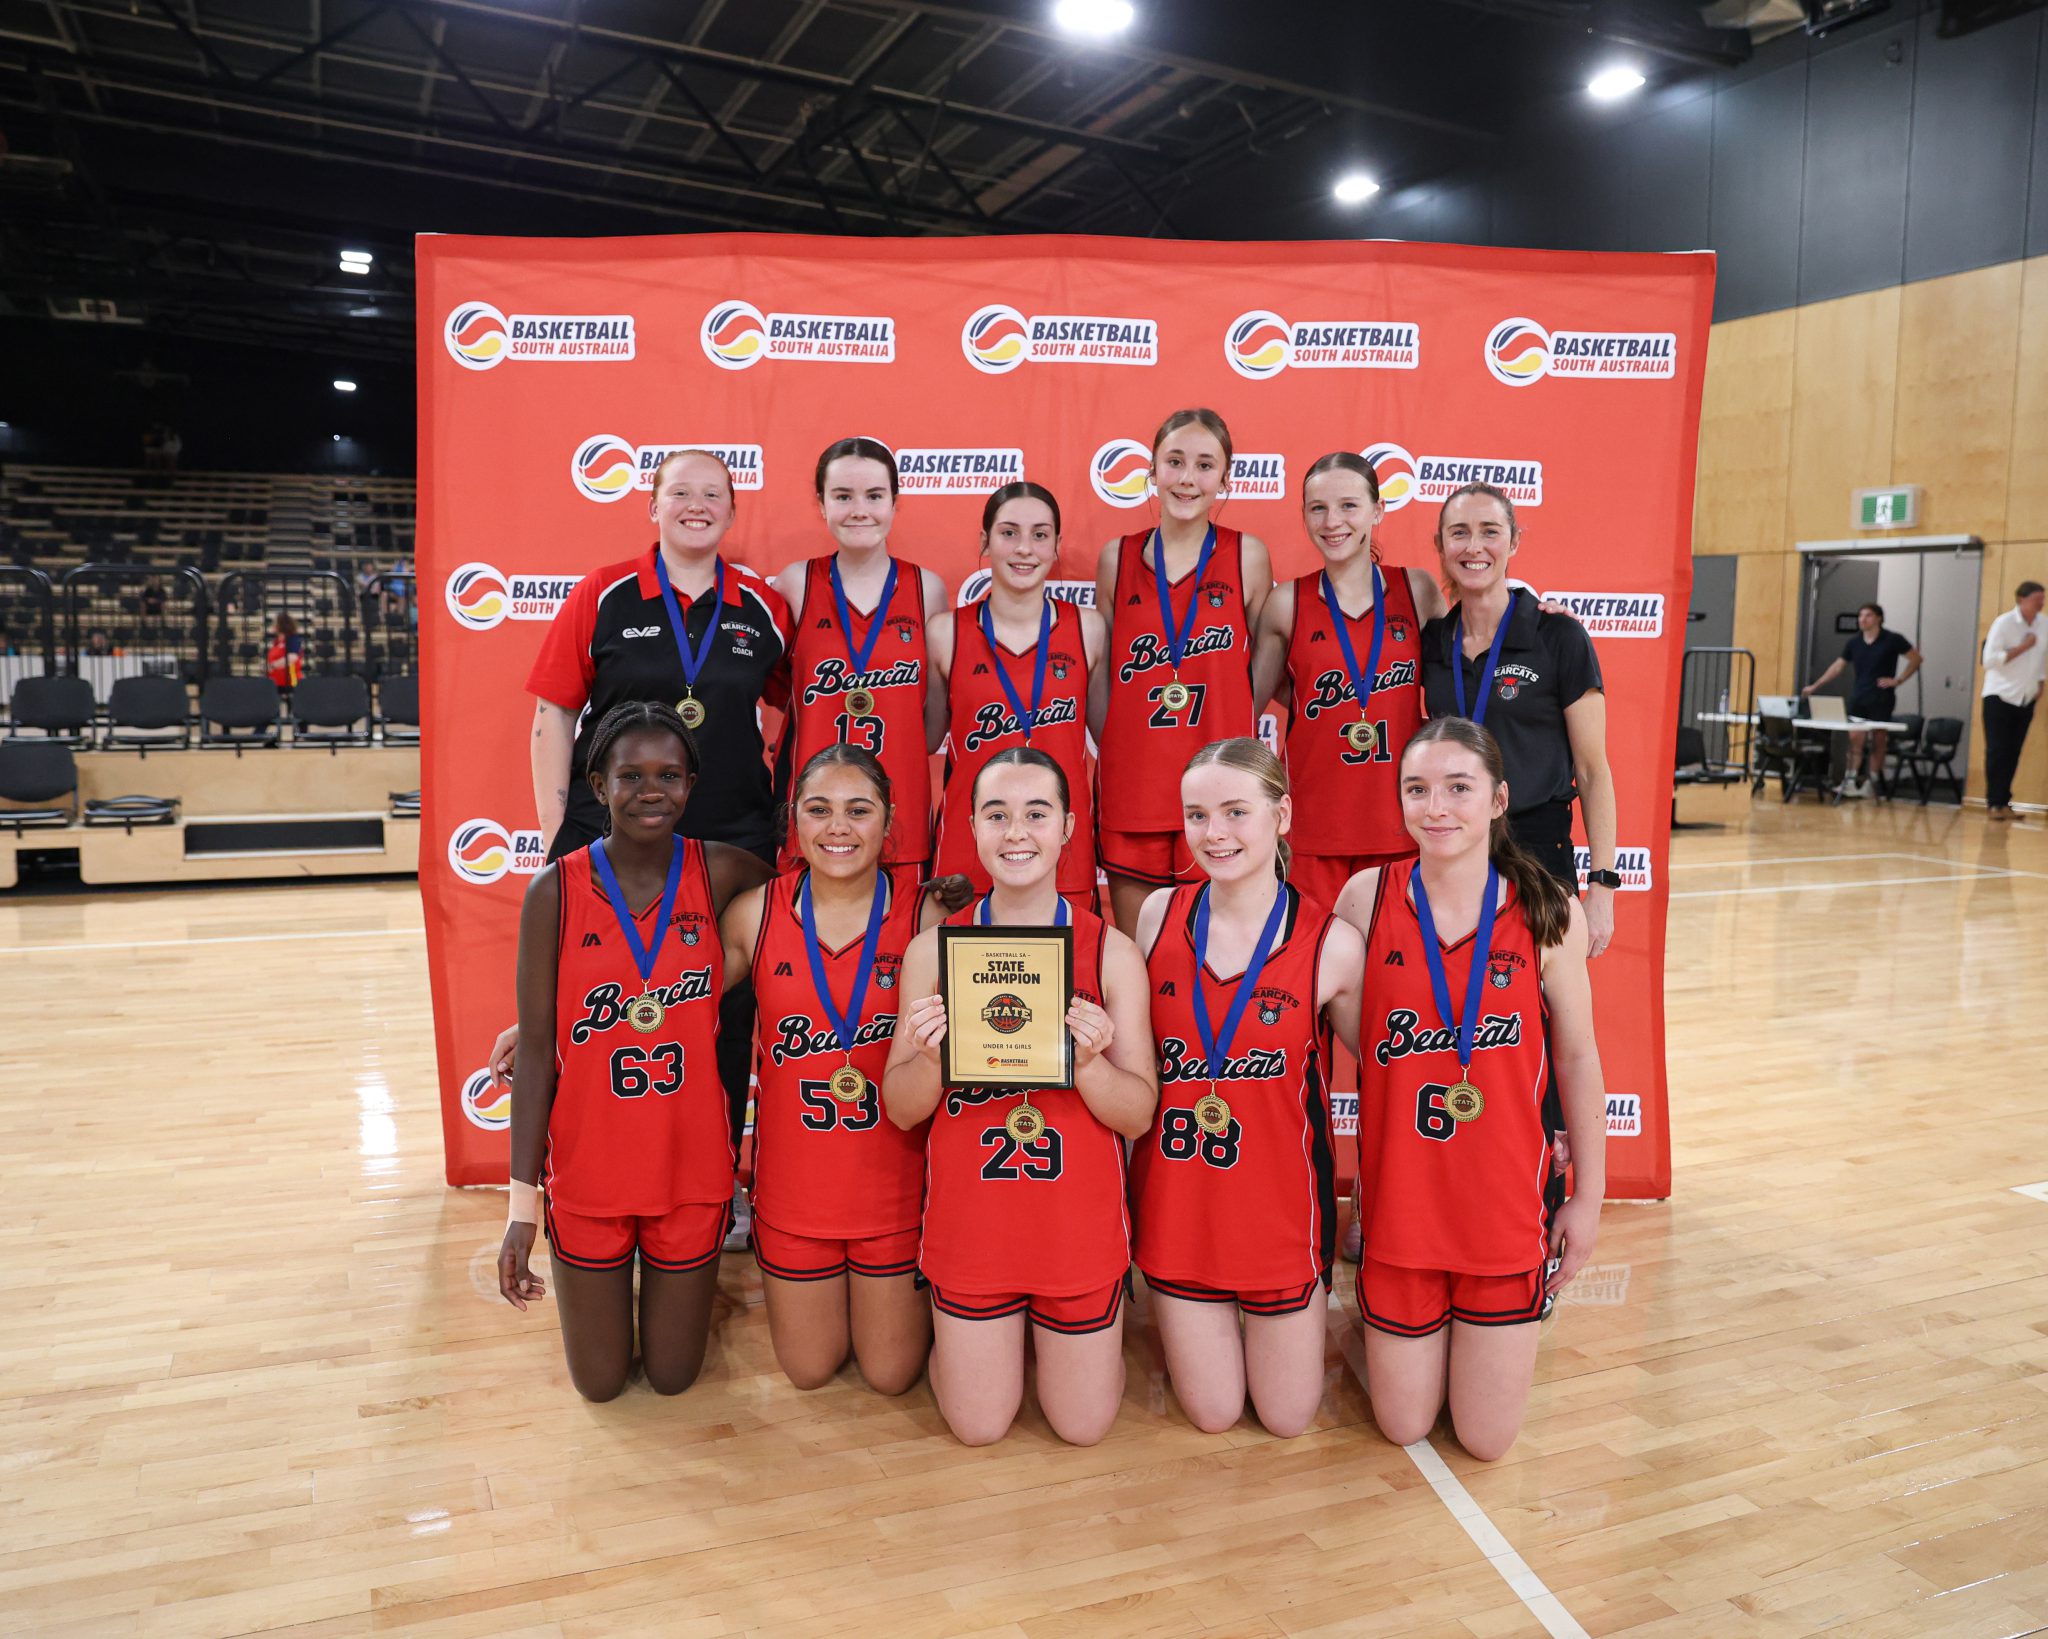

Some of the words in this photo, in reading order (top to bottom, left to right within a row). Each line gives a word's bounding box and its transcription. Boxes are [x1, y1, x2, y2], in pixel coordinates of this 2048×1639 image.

[512, 321, 629, 340] BASKETBALL
[769, 319, 889, 342] BASKETBALL
[1032, 322, 1152, 344] BASKETBALL
[1294, 327, 1413, 348] BASKETBALL
[512, 342, 555, 354] SOUTH
[559, 342, 629, 355] AUSTRALIA
[769, 340, 813, 354] SOUTH
[817, 342, 889, 357] AUSTRALIA
[1032, 343, 1075, 356] SOUTH
[1079, 344, 1151, 359] AUSTRALIA
[1294, 349, 1337, 362] SOUTH
[1342, 350, 1413, 363] AUSTRALIA
[1553, 338, 1670, 358] BASKETBALL
[1552, 358, 1595, 372] SOUTH
[1599, 360, 1670, 373] AUSTRALIA
[899, 454, 1018, 473] BASKETBALL
[898, 475, 942, 488] SOUTH
[1419, 462, 1537, 485] BASKETBALL
[512, 581, 577, 600] BASKE
[512, 602, 555, 614] SOUTH
[1546, 597, 1659, 618] ASKETBALL
[720, 623, 761, 638] BEARCATS
[1587, 618, 1657, 632] AUSTRALIA
[731, 646, 754, 657] COACH
[1493, 666, 1540, 682] EARCATS
[1147, 683, 1207, 729] 27
[834, 712, 886, 757] 13
[514, 856, 547, 868] SOUT
[667, 914, 709, 926] EARCATS
[987, 960, 1025, 972] STATE
[1488, 952, 1527, 969] ARCATS
[972, 972, 1041, 984] CHAMPION
[1250, 989, 1301, 1009] EARCATS
[635, 1011, 658, 1019] STATE
[982, 1006, 1032, 1020] STATE
[609, 1041, 685, 1099] 63
[799, 1078, 881, 1132] 53
[1414, 1082, 1457, 1142] 6
[1014, 1120, 1037, 1129] STATE
[1160, 1106, 1243, 1170] 88
[980, 1126, 1064, 1182] 29
